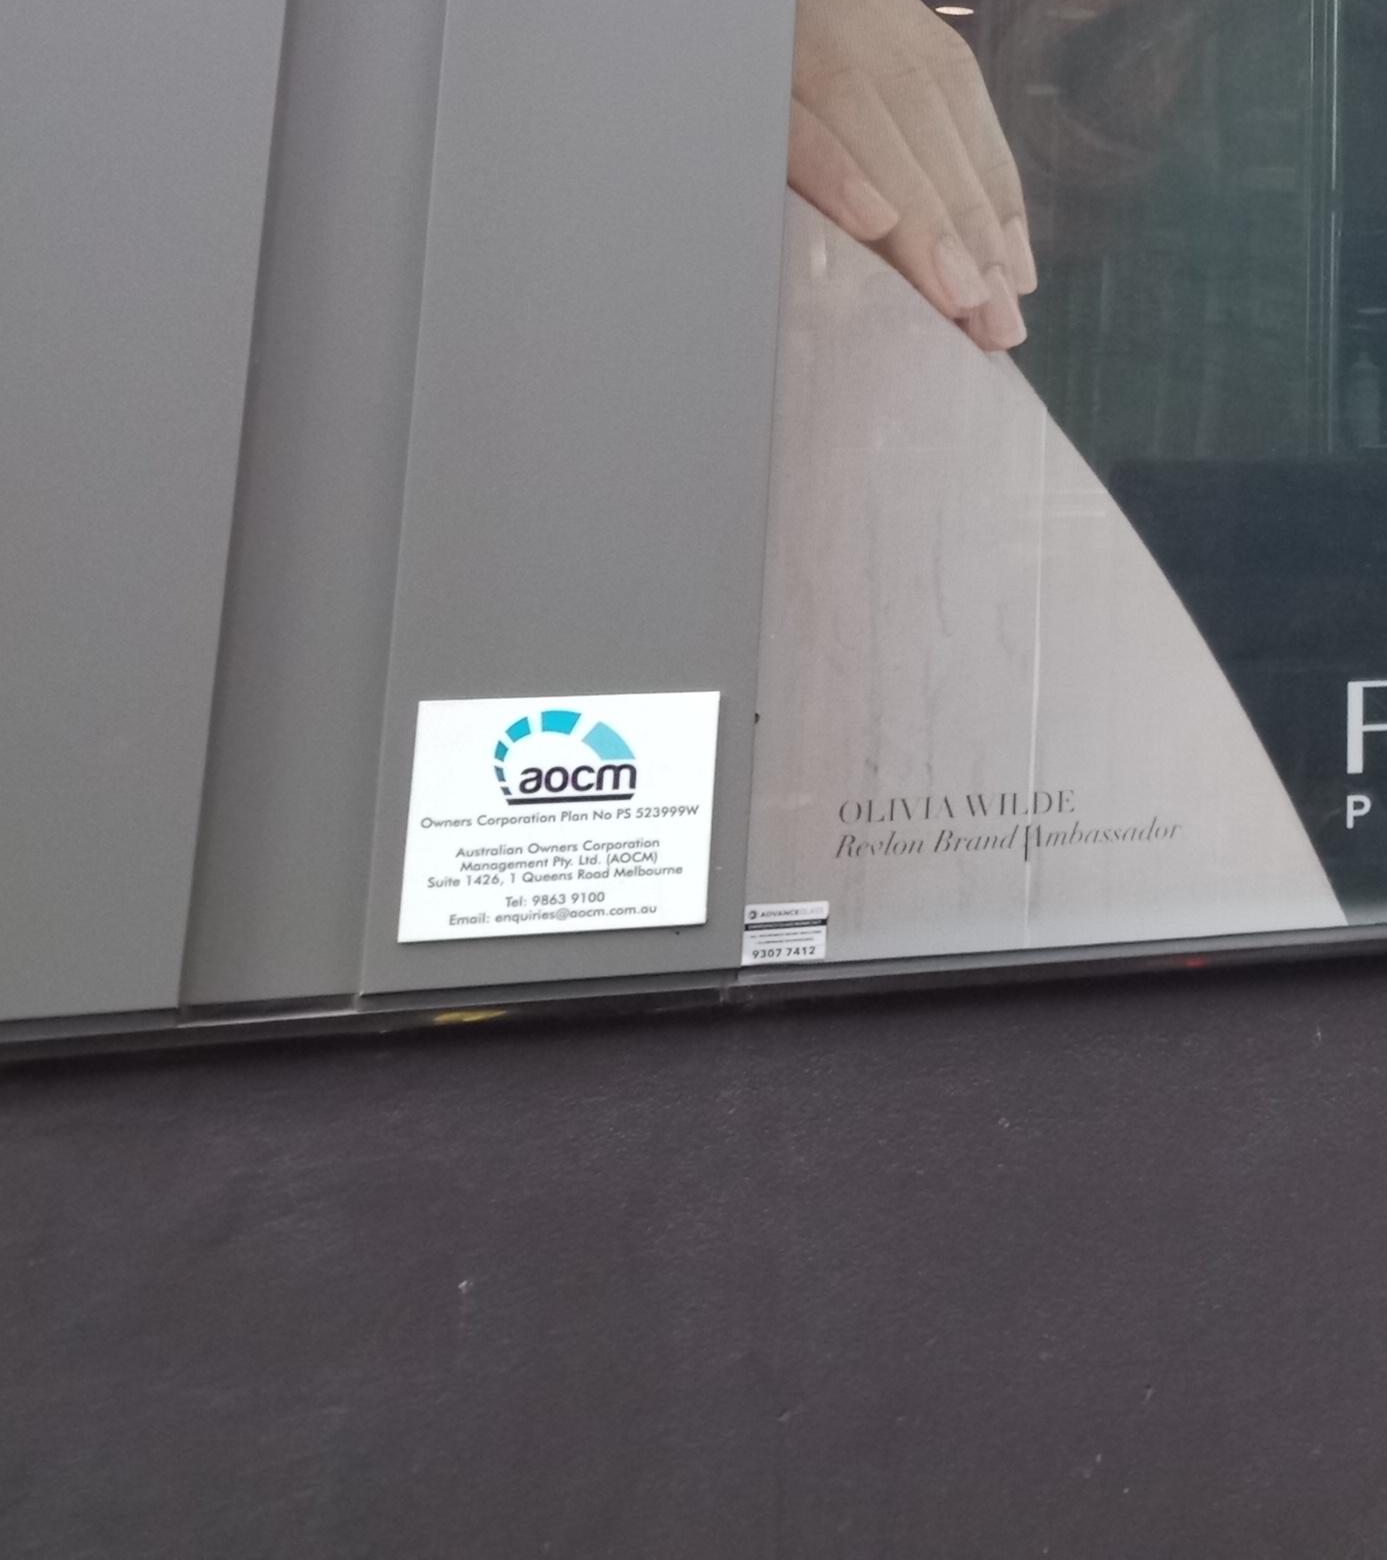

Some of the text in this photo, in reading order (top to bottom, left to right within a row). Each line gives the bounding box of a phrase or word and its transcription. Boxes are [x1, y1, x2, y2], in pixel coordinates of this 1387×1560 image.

[519, 763, 637, 794] aocm
[420, 804, 700, 828] Owners Corporation Plan No PS 523999W
[838, 789, 1075, 824] OLIVIA WILDE
[455, 838, 660, 858] Australian Owners Corporation
[835, 816, 1182, 859] Revlon Brand Ambassador
[460, 852, 658, 872] Management Pty. Ltd. (AOCM)
[427, 865, 683, 888] Suite 1426, 1 Queens Road Melbourne
[505, 891, 605, 908] Tel: 9863 9100
[449, 905, 657, 925] Email: enquiries@aocm.com.au
[752, 946, 815, 958] 9307 7412
